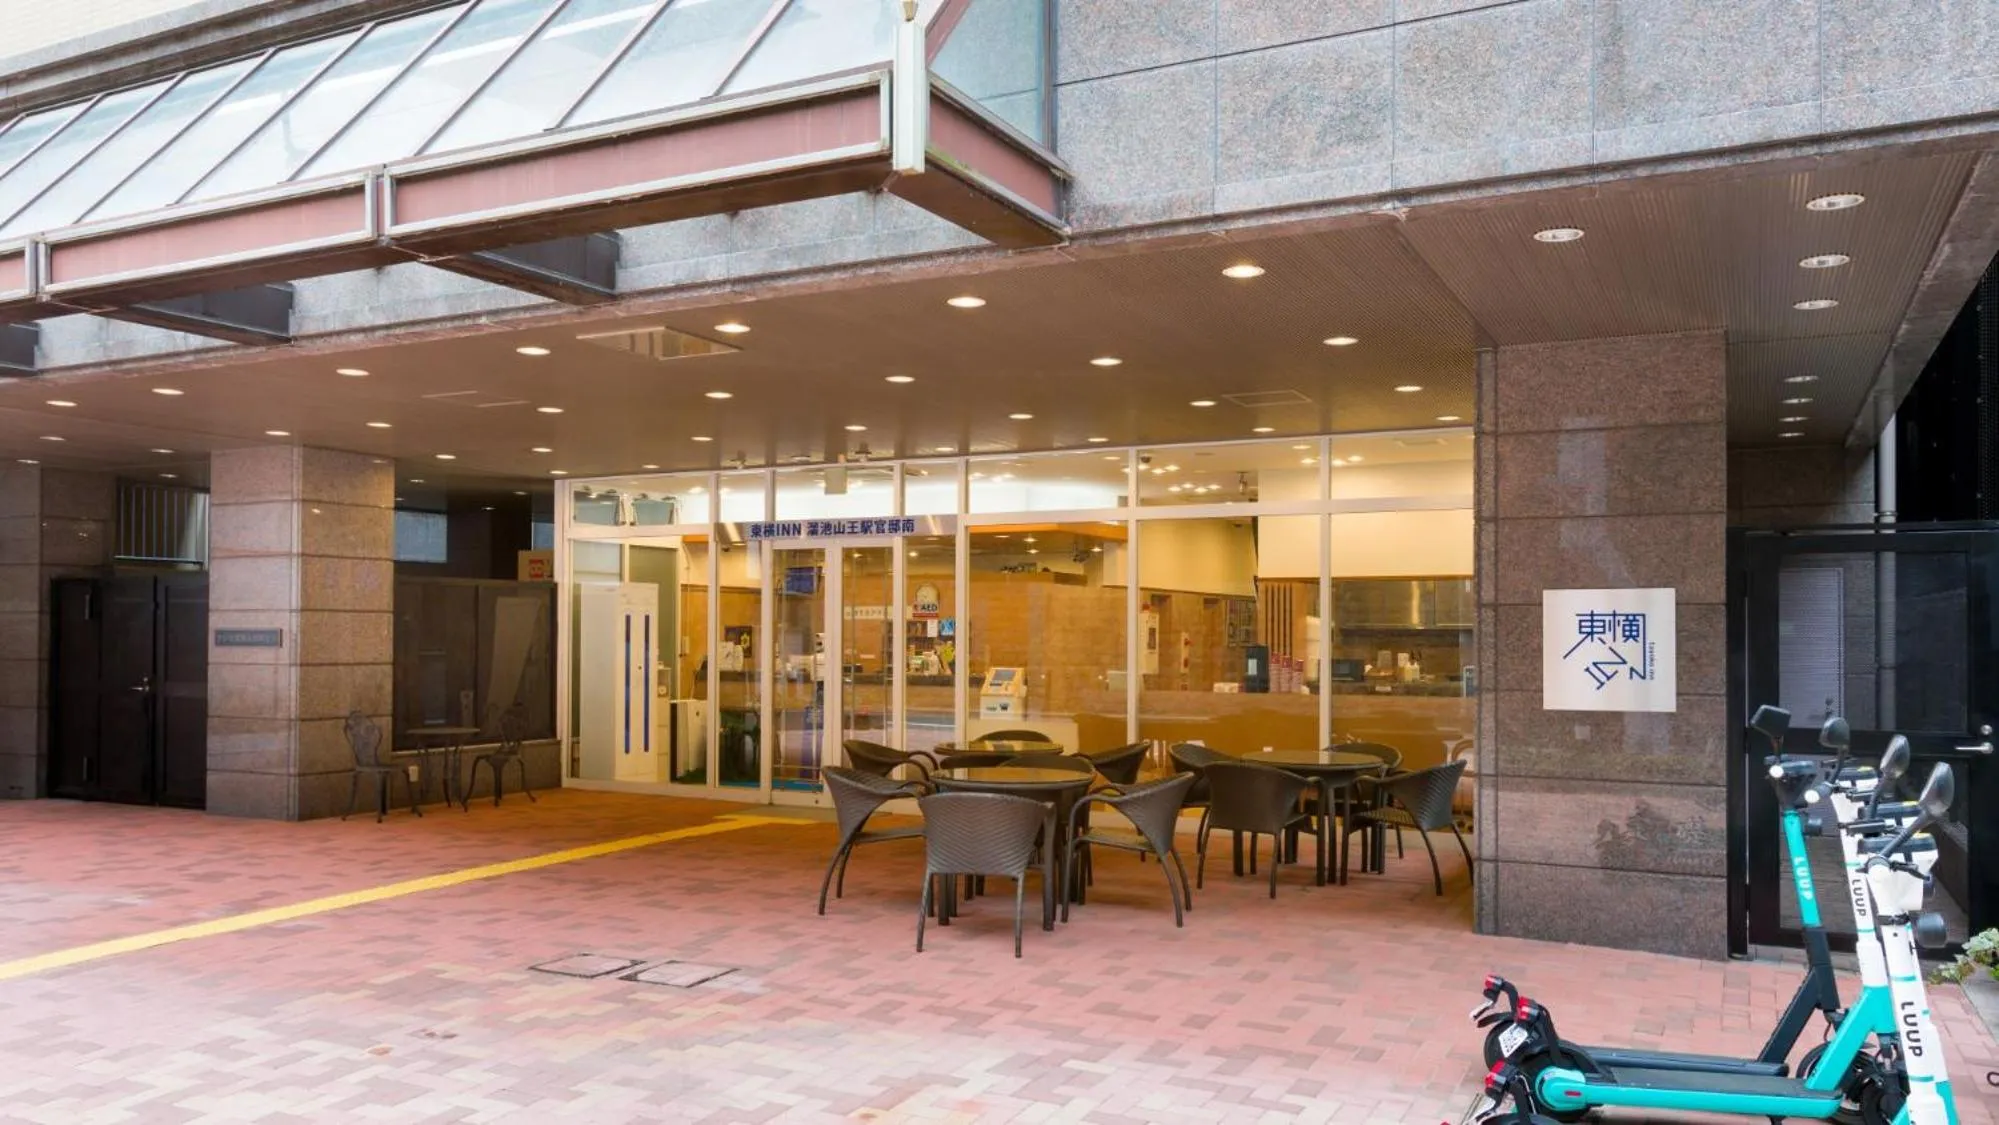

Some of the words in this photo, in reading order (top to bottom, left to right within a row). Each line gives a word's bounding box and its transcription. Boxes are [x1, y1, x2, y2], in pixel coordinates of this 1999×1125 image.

[751, 523, 801, 538] 東横INN
[920, 603, 938, 612] AED
[1794, 856, 1813, 901] LUUP
[1851, 878, 1867, 917] LUUP
[1901, 1001, 1923, 1058] LUUP
